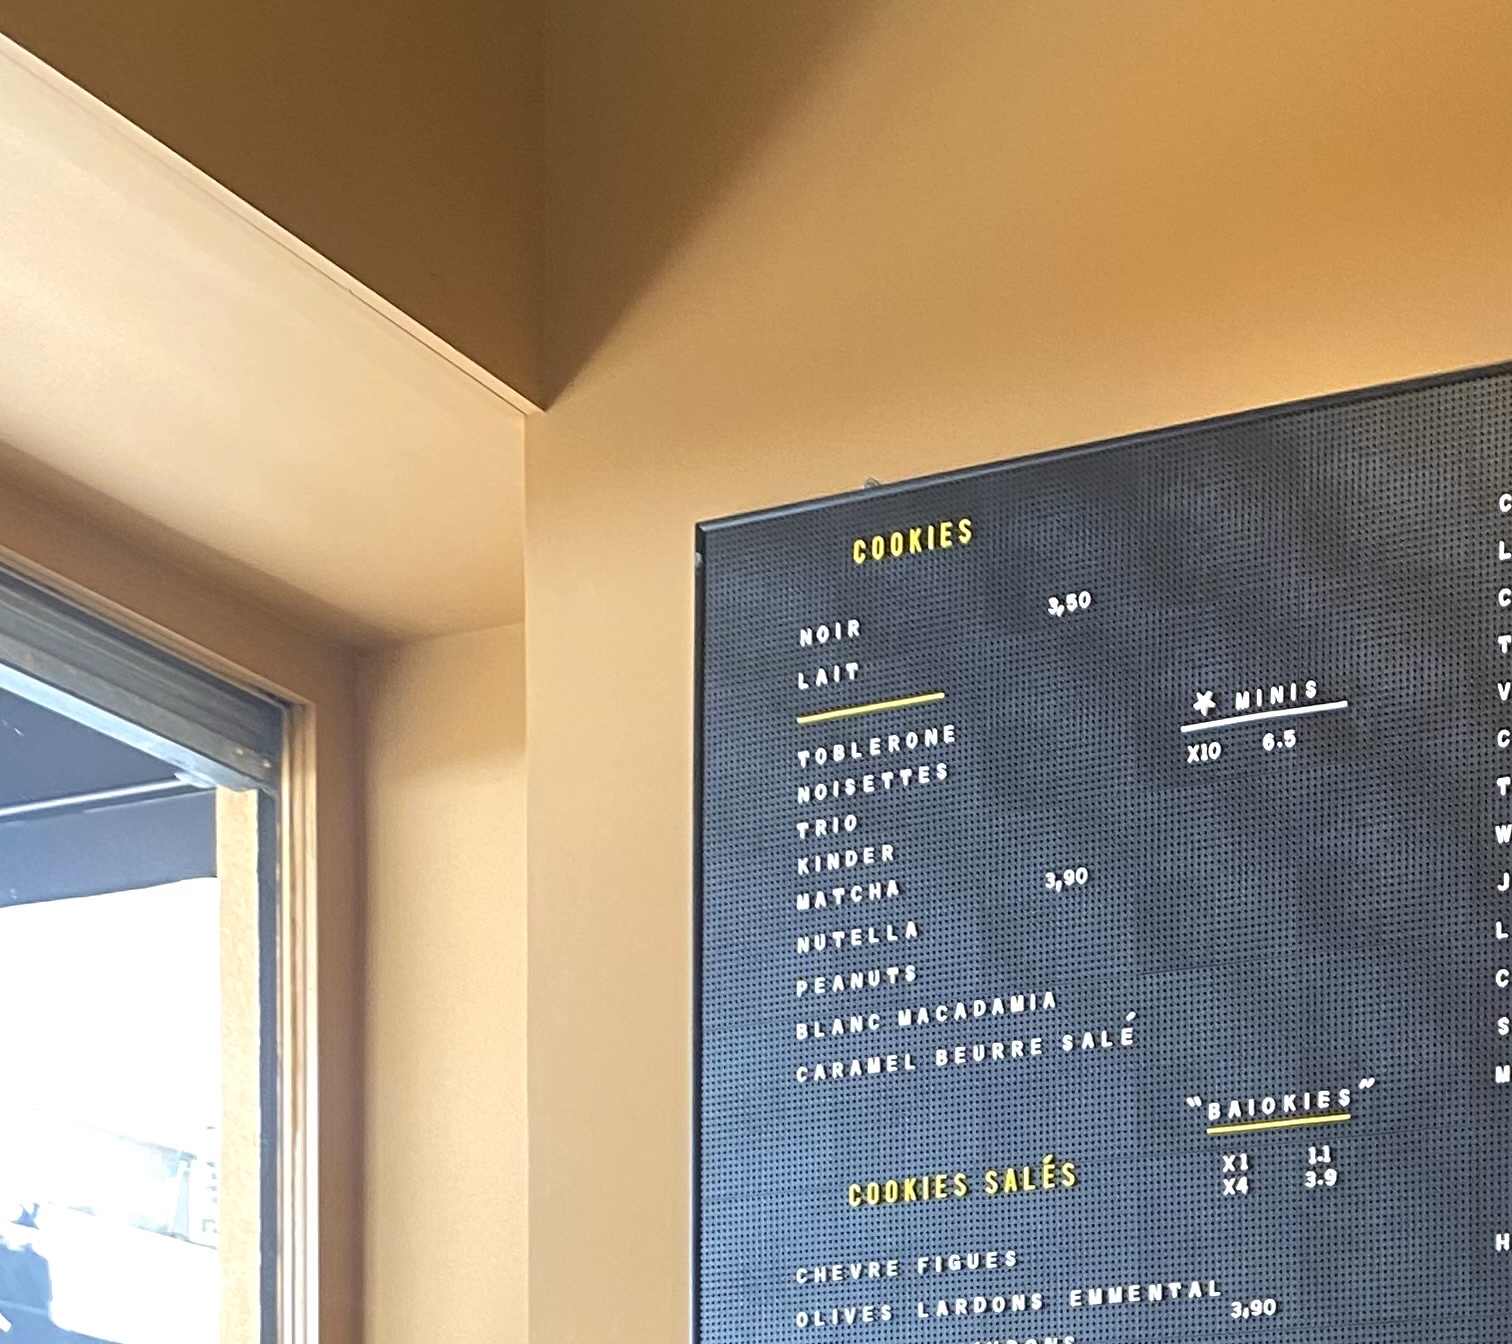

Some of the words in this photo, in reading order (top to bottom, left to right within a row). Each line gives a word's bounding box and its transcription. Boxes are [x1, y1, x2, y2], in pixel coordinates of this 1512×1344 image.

[853, 518, 972, 564] COOKIES
[1047, 590, 1091, 617] 3,50
[799, 619, 860, 647] NOIR
[798, 662, 859, 690] LAIT
[1235, 680, 1317, 711] MINIS
[797, 724, 955, 769] TOBLERONE
[1186, 741, 1222, 764] X10
[1262, 729, 1296, 752] 6.5
[797, 762, 947, 804] NOISETTES
[796, 814, 857, 840] TRIO
[797, 844, 894, 876] KINDER
[796, 879, 899, 911] MATCHA
[1045, 867, 1088, 893] 3,90
[797, 921, 917, 954] NUTELLA
[796, 964, 916, 998] PEANUTS
[796, 1013, 880, 1041] BLANC
[898, 991, 1056, 1027] MACADAMIA
[796, 1053, 916, 1083] CARAMEL
[935, 1037, 1042, 1067] BEURRE
[1062, 1011, 1136, 1052] SALÉ
[1222, 1153, 1249, 1173] X1
[1308, 1145, 1331, 1165] 1.1
[848, 1172, 967, 1208] COOKIES
[985, 1154, 1075, 1195] SALÉS
[1222, 1176, 1249, 1196] X4
[1304, 1168, 1338, 1188] 3.9
[796, 1259, 898, 1284] CHEVRE
[917, 1250, 1016, 1275] FIGUES
[795, 1304, 892, 1328] OLIVES
[917, 1292, 1042, 1319] LARDONS
[1069, 1279, 1221, 1307] EMMENTAL
[1230, 1298, 1277, 1319] 3,90
